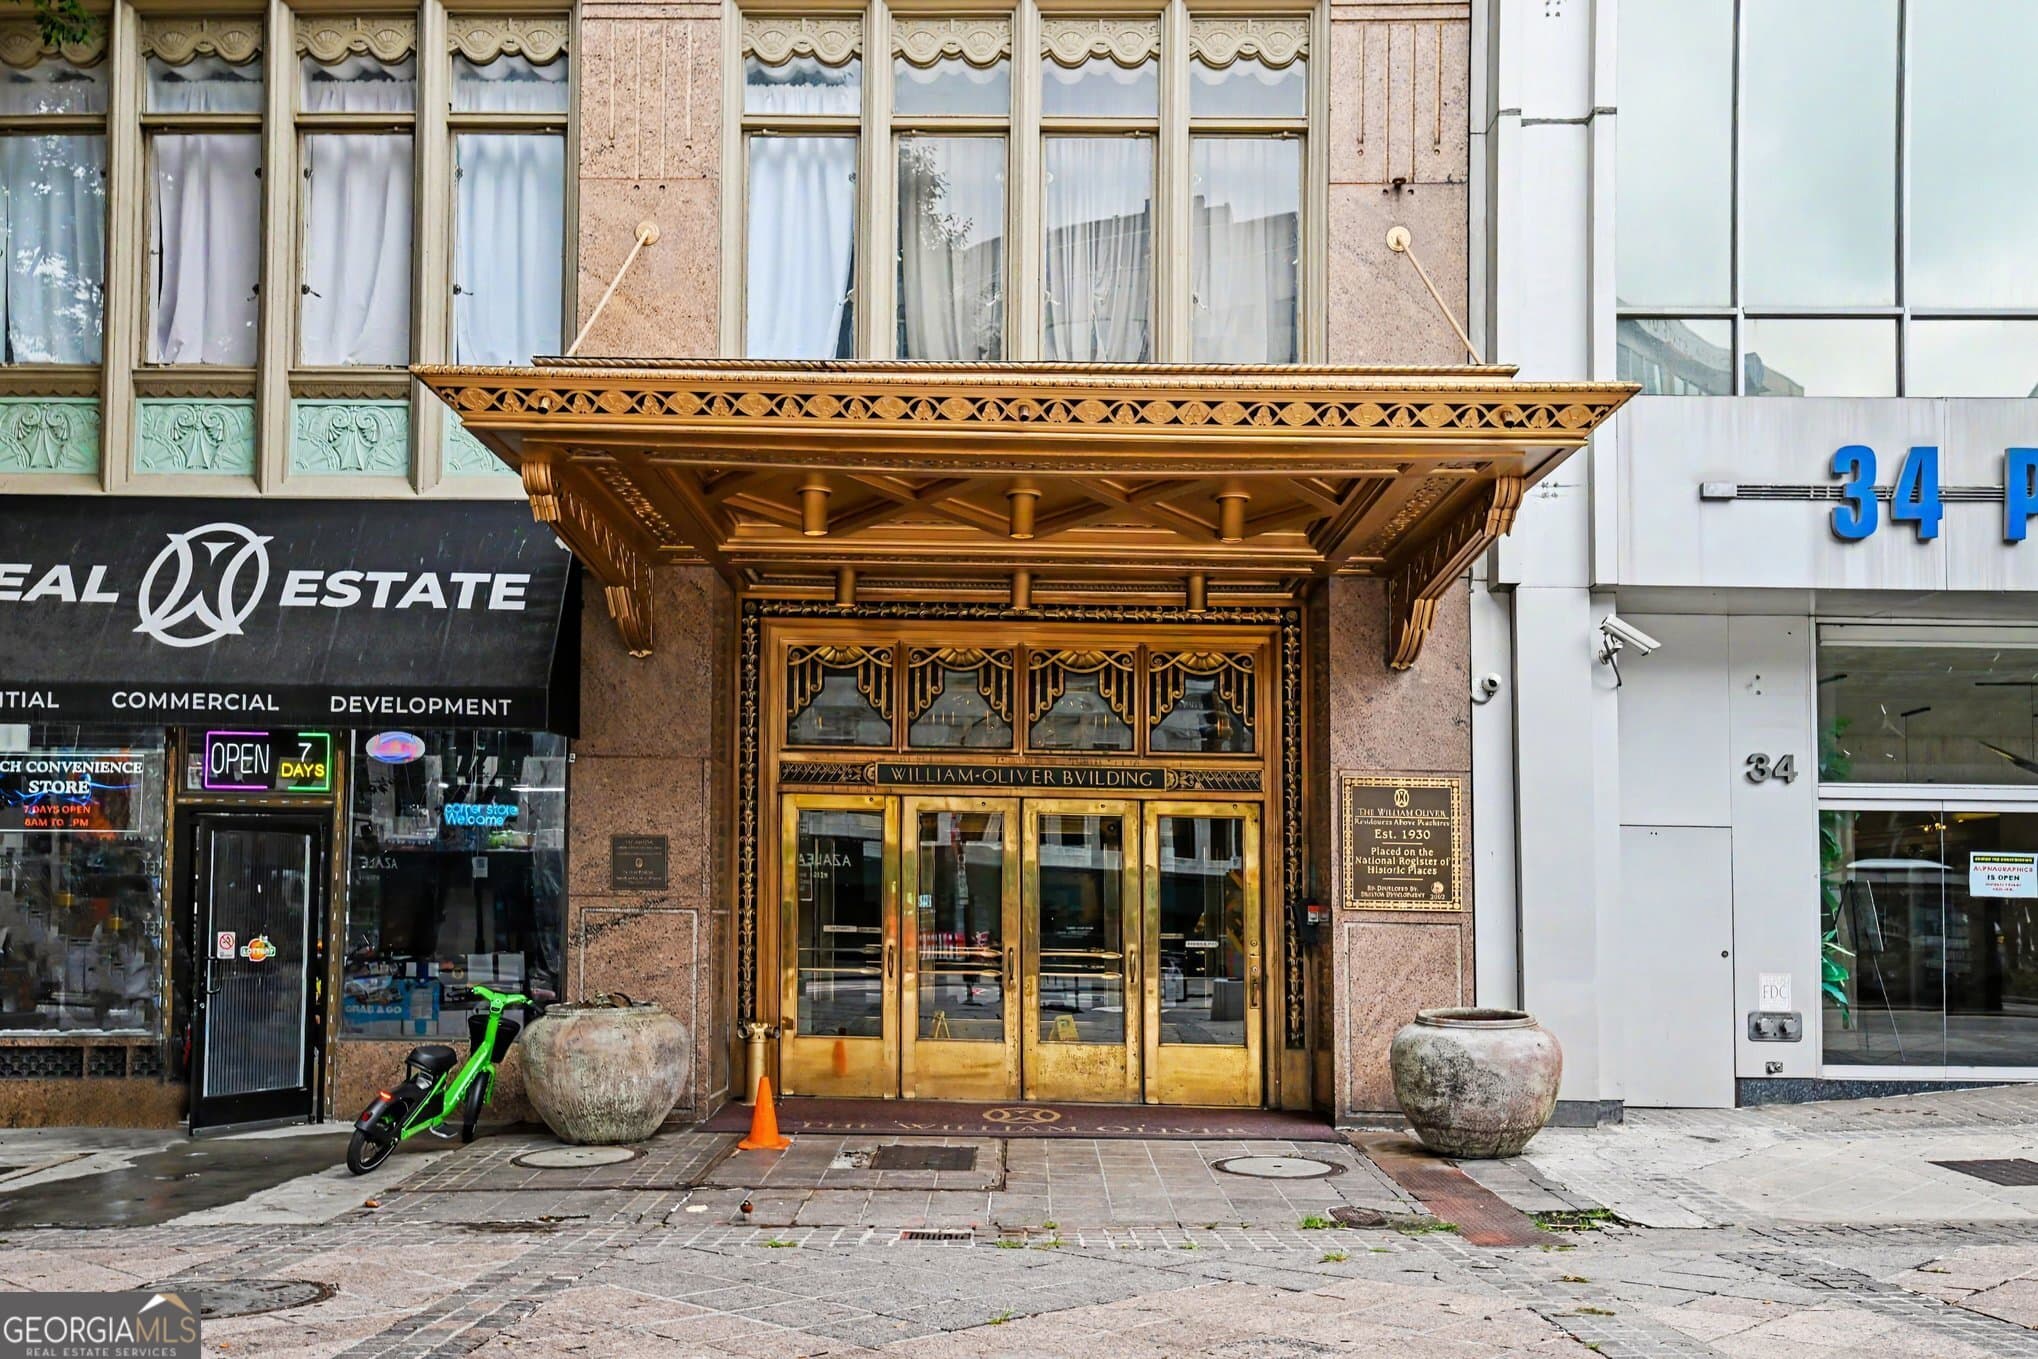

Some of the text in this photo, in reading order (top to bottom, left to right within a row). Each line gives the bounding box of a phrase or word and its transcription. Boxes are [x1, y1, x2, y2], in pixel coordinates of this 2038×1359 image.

[1829, 444, 1943, 540] 34
[279, 569, 531, 610] ESTATE
[111, 691, 280, 711] COMMERCIAL
[330, 695, 512, 715] DEVELOPMENT
[211, 742, 312, 774] OPEN 7
[26, 760, 143, 774] CONVENIENCE
[281, 762, 325, 777] DAYS
[1745, 752, 1799, 785] 34
[890, 766, 1055, 786] WILLIAM-OLIVER
[28, 780, 91, 794] STORE
[24, 804, 91, 814] 7 DAYS OPEN
[486, 802, 519, 816] store
[1358, 807, 1447, 817] THE WILLIAM OLIVER
[51, 818, 64, 827] TO
[445, 812, 505, 826] Welcome
[1394, 819, 1416, 827] Above
[1374, 829, 1431, 840] Est. 1930
[1371, 847, 1401, 856] Placed
[1418, 847, 1434, 857] the
[1355, 856, 1451, 868] National Register of
[1367, 865, 1438, 876] Historic Places
[1762, 984, 1788, 1000] FDC
